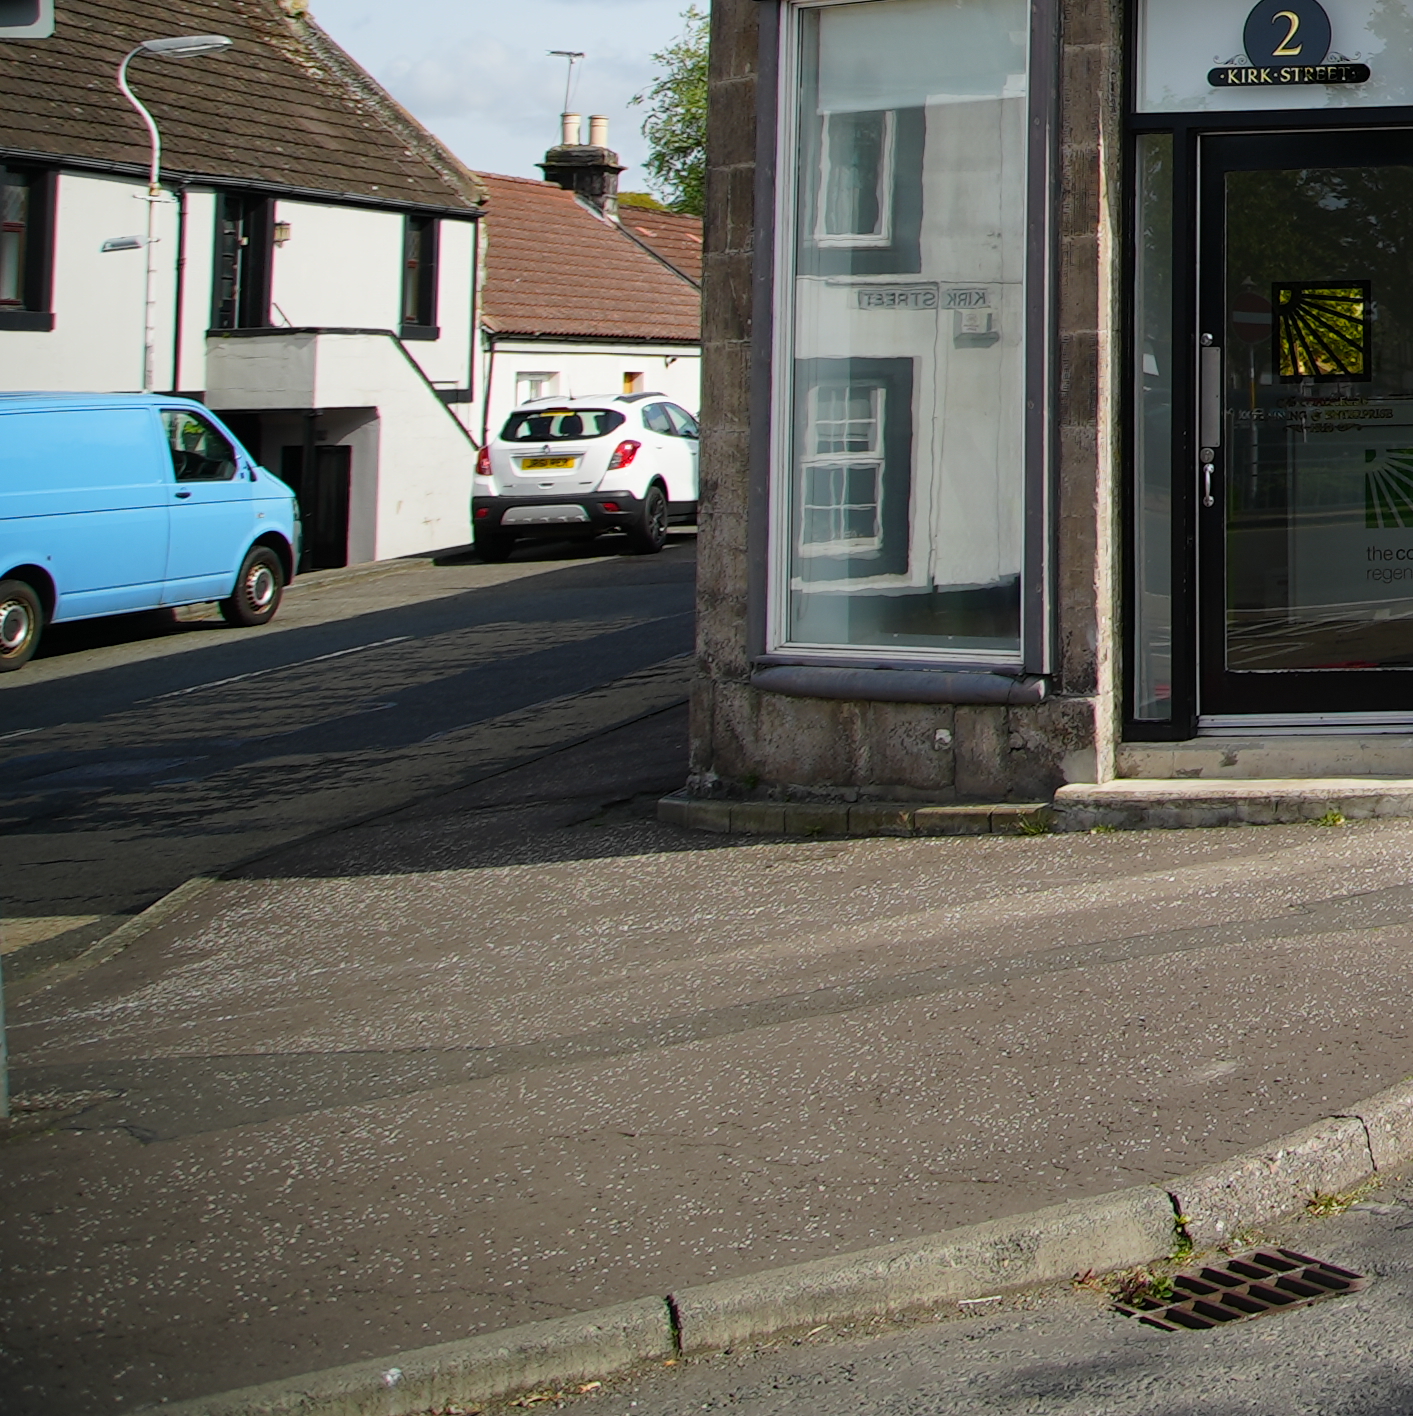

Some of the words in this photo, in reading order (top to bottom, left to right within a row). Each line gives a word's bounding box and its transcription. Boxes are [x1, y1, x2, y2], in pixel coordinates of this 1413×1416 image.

[1270, 9, 1304, 57] 2
[1227, 67, 1273, 84] KIRK
[1280, 66, 1350, 83] STREET
[1366, 545, 1394, 561] the
